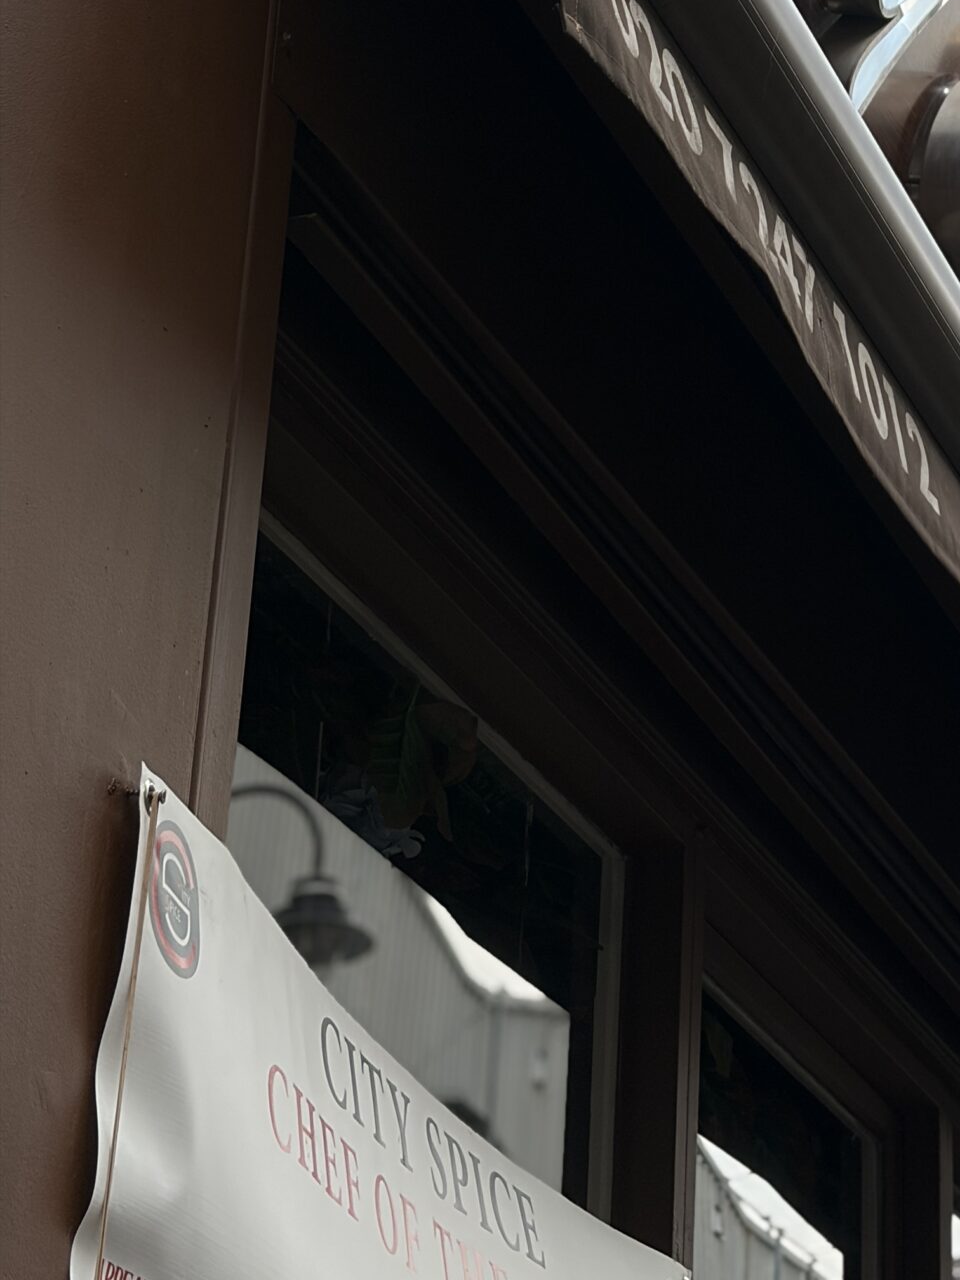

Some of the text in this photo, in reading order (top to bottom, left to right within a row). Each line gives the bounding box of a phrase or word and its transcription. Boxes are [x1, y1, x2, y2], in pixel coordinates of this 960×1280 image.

[704, 104, 815, 333] 7247
[832, 301, 942, 516] 1012
[267, 1064, 361, 1222] CHEF
[374, 1174, 420, 1274] OF
[320, 1016, 546, 1270] CITY SPICE
